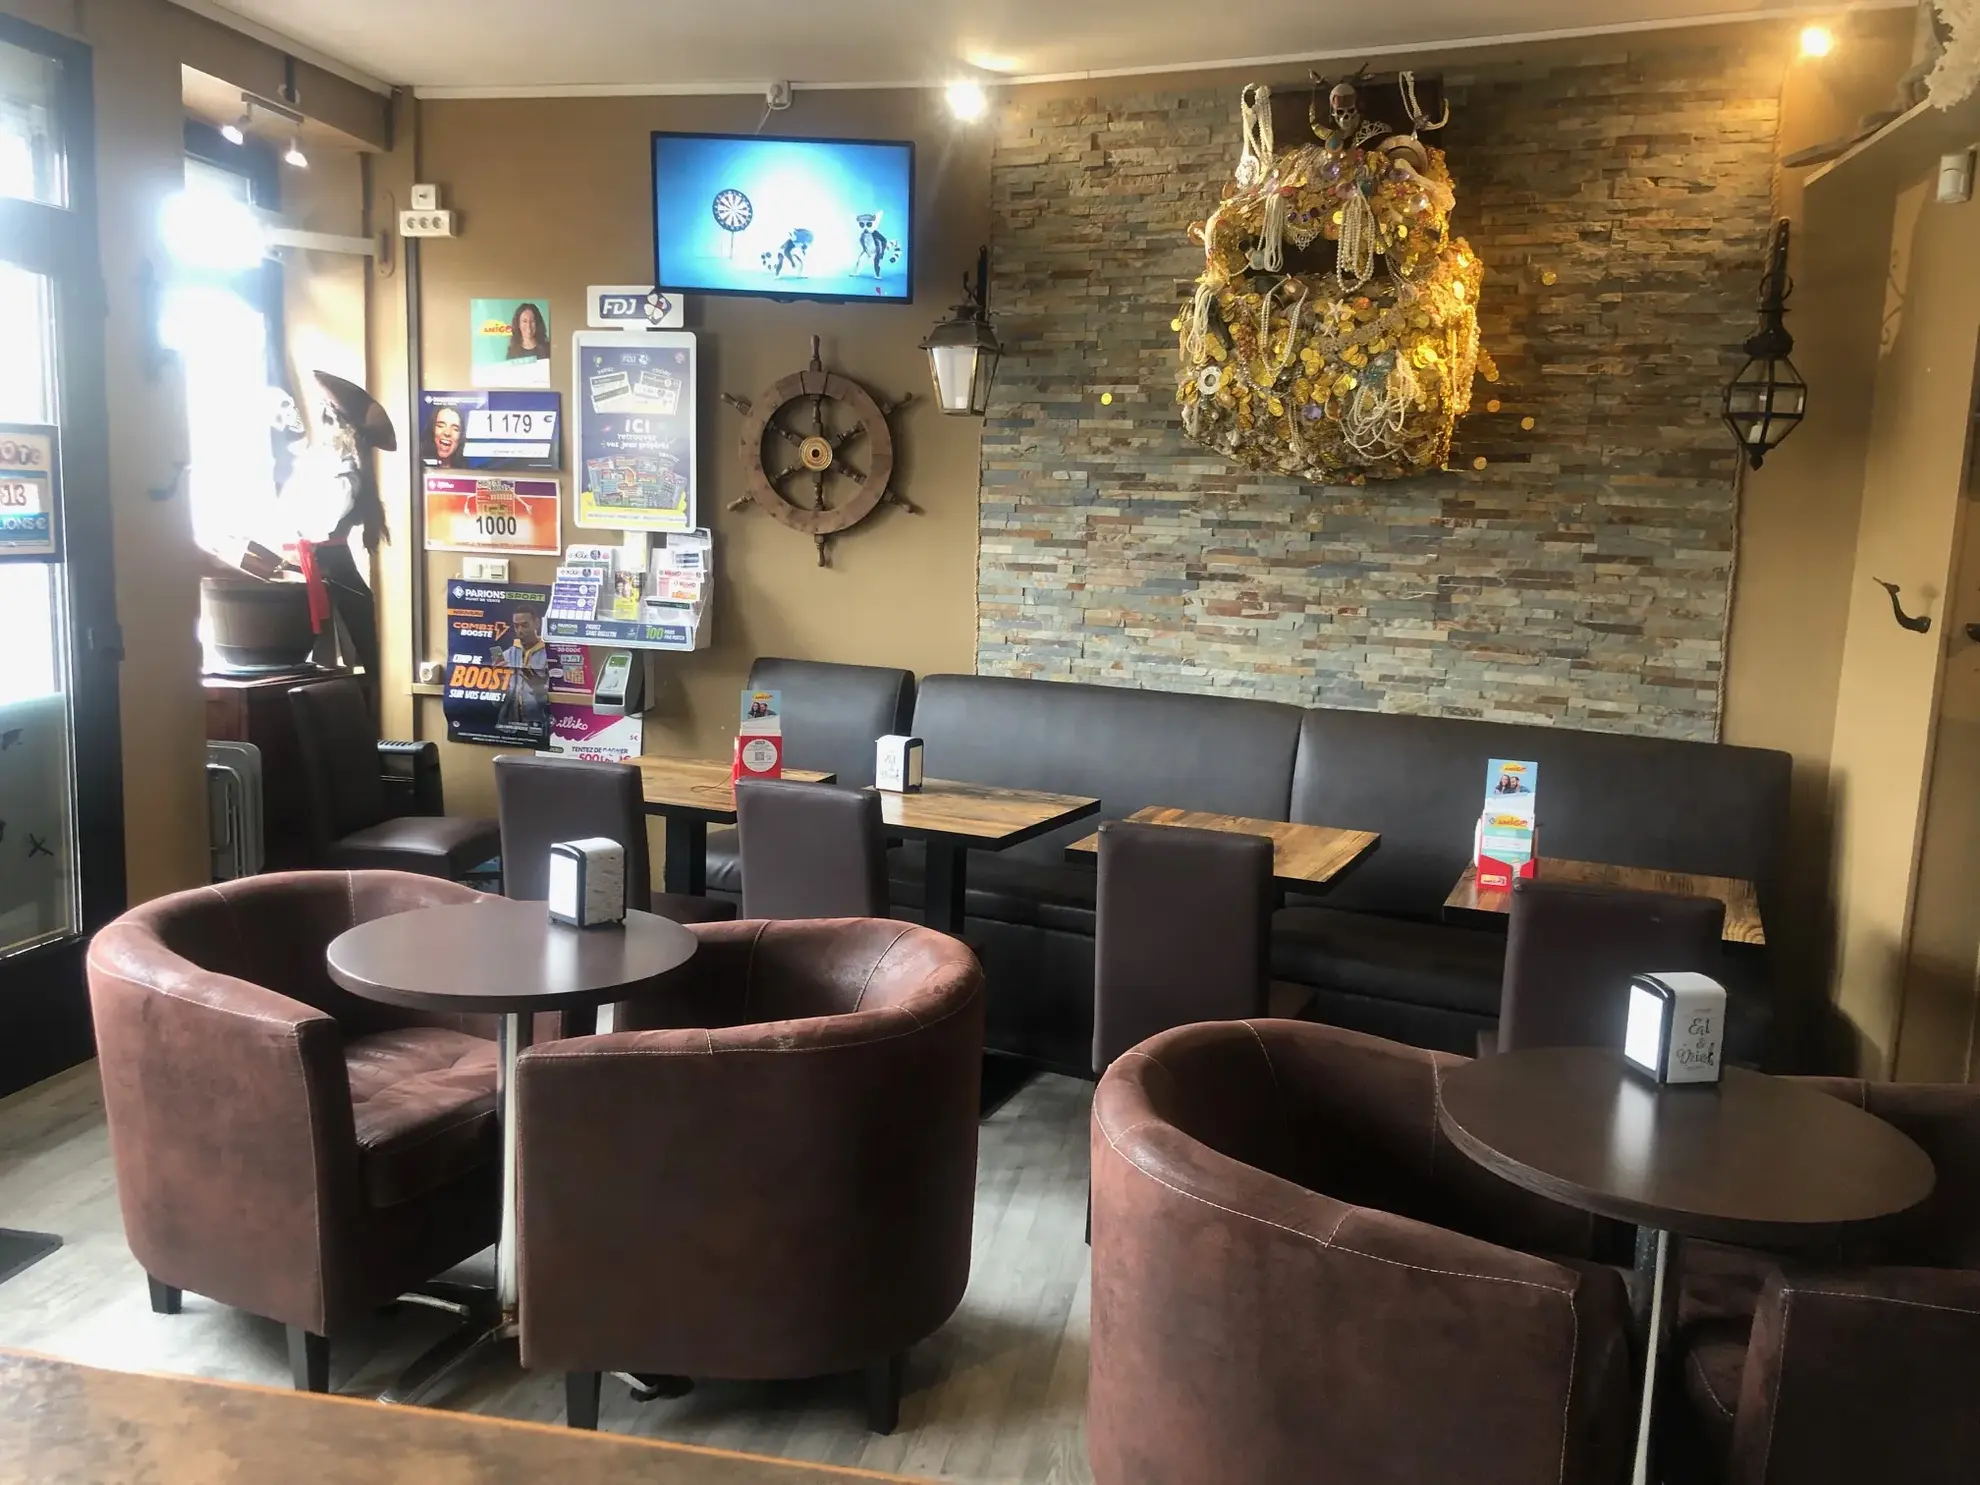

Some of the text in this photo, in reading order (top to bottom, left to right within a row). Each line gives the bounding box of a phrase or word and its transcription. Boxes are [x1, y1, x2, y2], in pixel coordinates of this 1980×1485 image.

[603, 298, 636, 315] FDJ
[502, 414, 532, 433] 179
[625, 418, 650, 434] ICI
[476, 515, 517, 536] 1000
[465, 588, 544, 601] PARIONS SPORT
[453, 621, 495, 631] COMBI
[645, 627, 664, 640] 100
[449, 664, 513, 691] BOOST
[448, 689, 465, 699] SUR
[464, 690, 480, 700] VOS
[479, 691, 502, 702] GAINS
[556, 715, 589, 731] illiko
[1688, 1017, 1711, 1036] Eat
